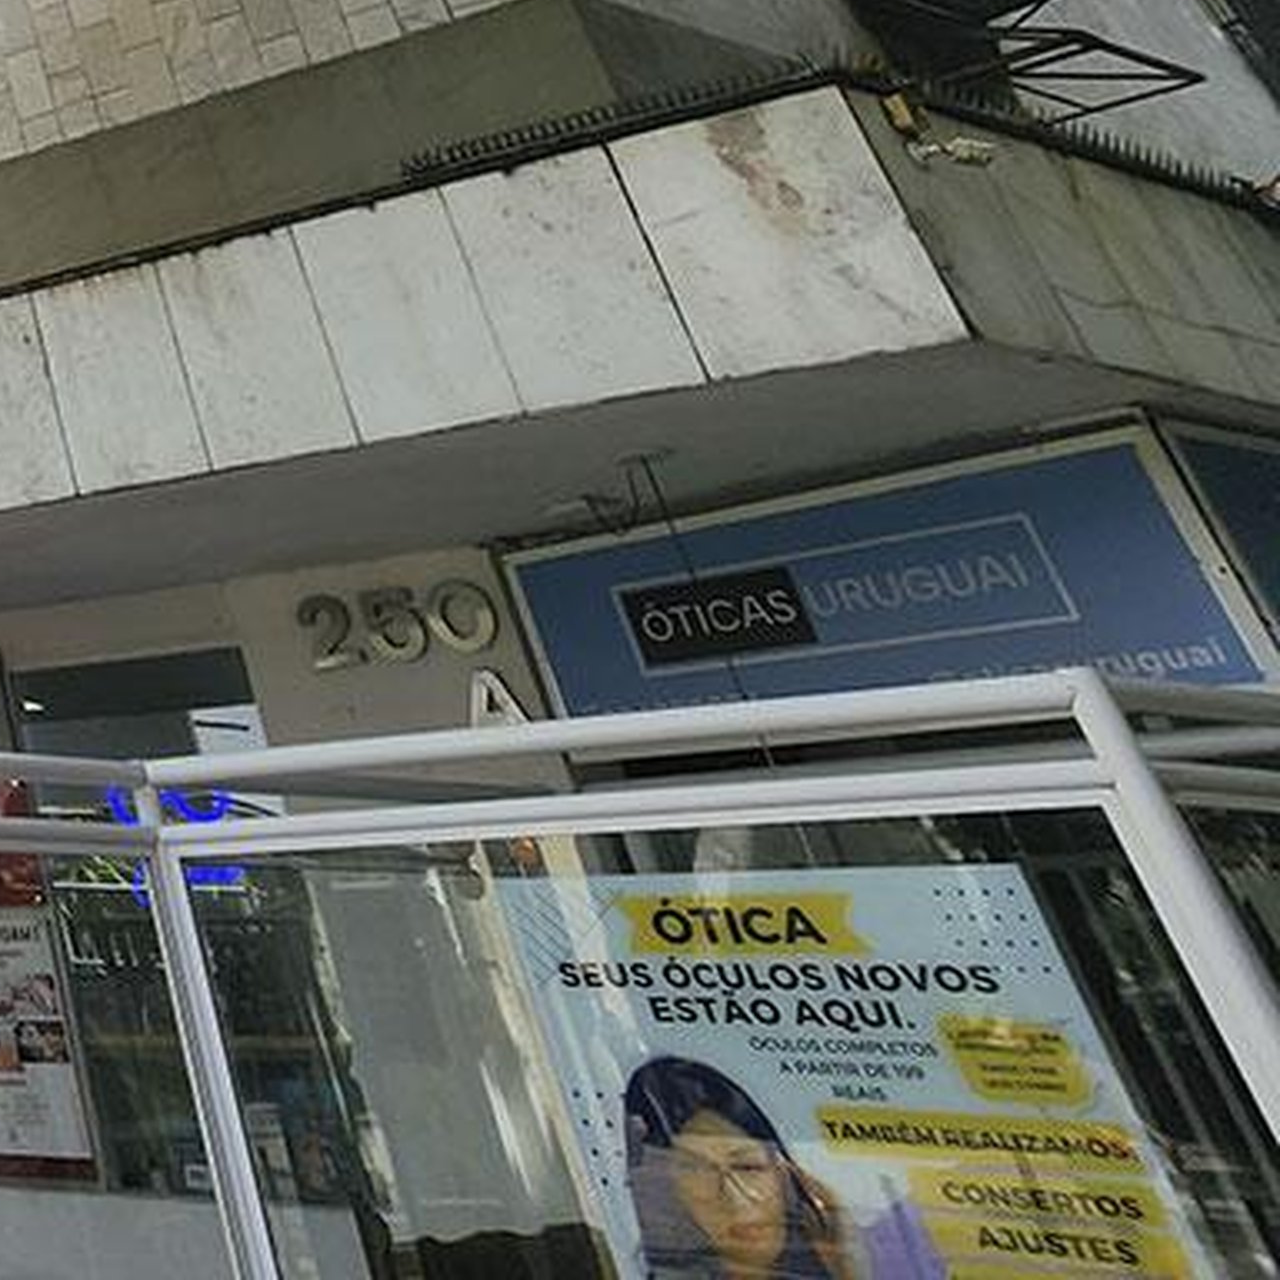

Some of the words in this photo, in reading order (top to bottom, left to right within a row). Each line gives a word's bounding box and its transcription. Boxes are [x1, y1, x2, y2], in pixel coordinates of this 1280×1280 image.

[642, 587, 798, 643] ÓTICAS
[805, 552, 1030, 617] URUGUAI
[297, 580, 499, 670] 250
[651, 897, 828, 945] ÓTICA
[558, 960, 655, 988] SEUS
[662, 956, 827, 992] ÓCULOS
[837, 963, 1002, 994] NOVOS
[648, 991, 782, 1025] ESTÃO
[795, 997, 917, 1033] AQUI.
[823, 1118, 937, 1145] TAMBÉM
[941, 1180, 1144, 1221] CONSERTOS
[978, 1226, 1140, 1266] AJUSTES
